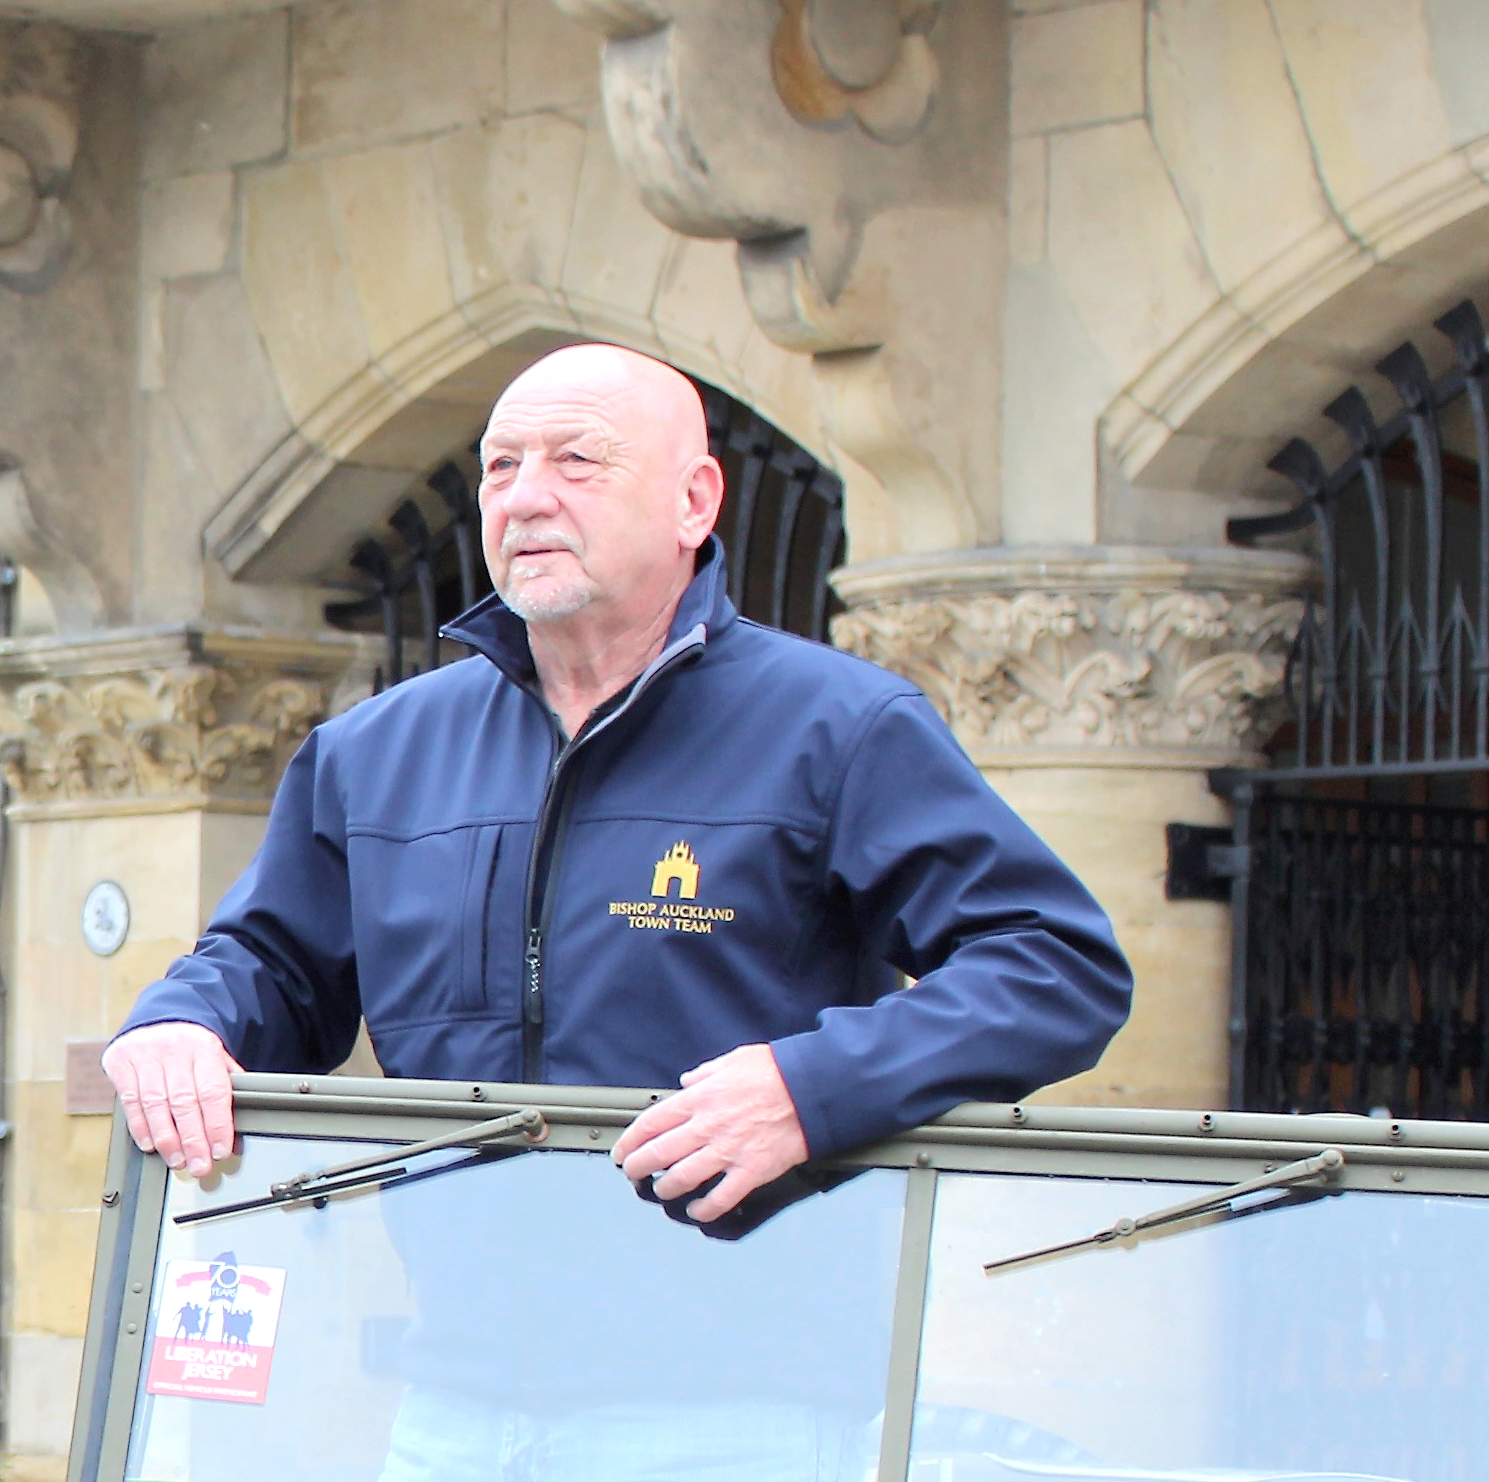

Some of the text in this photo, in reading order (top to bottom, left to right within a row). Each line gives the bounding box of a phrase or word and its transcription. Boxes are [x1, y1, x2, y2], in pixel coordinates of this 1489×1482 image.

[608, 902, 735, 922] BISHOP AUCKLAND
[628, 916, 713, 933] TOWN TEAM
[164, 1345, 258, 1368] LIBERATION
[181, 1363, 234, 1381] JERSEY
